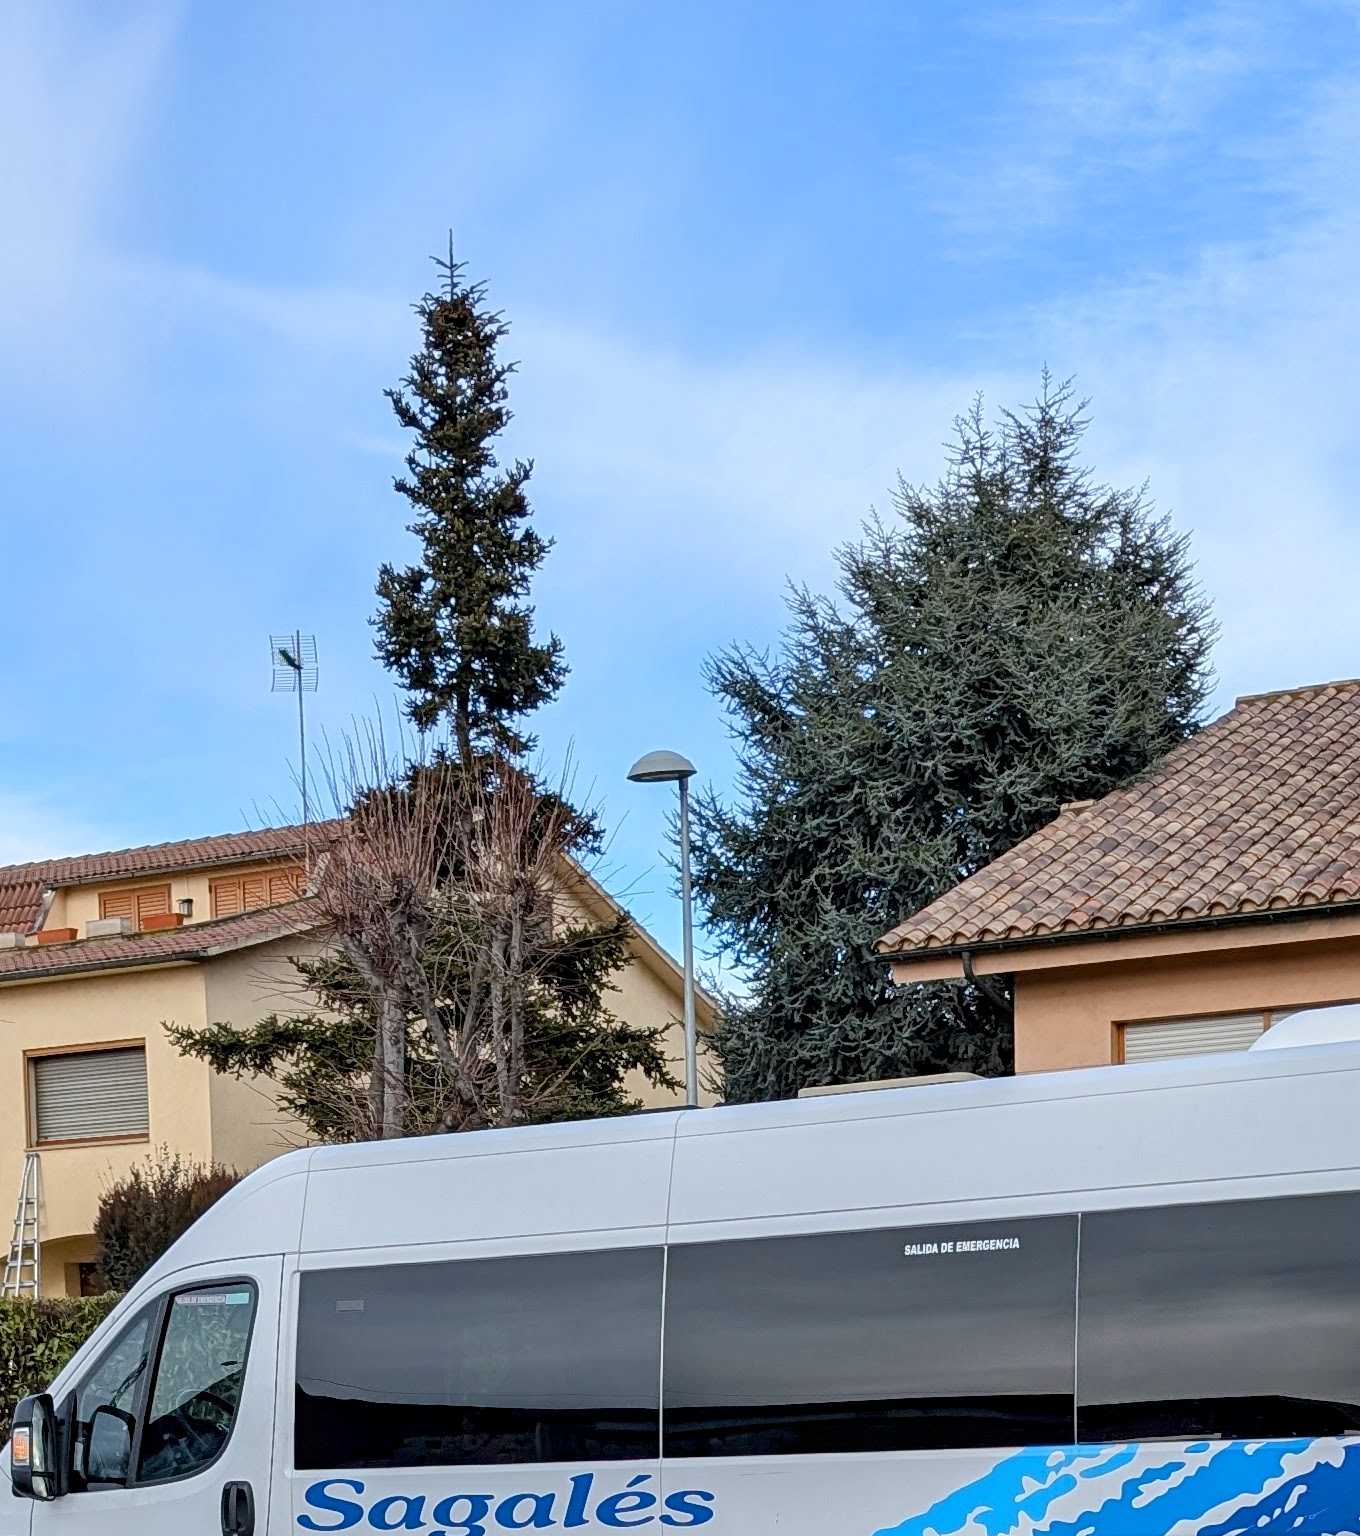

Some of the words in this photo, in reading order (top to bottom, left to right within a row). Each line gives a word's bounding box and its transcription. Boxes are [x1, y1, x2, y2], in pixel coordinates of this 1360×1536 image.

[904, 1244, 939, 1256] SALIDA
[940, 1242, 954, 1253] DE
[955, 1238, 1020, 1252] EMERGENCIA
